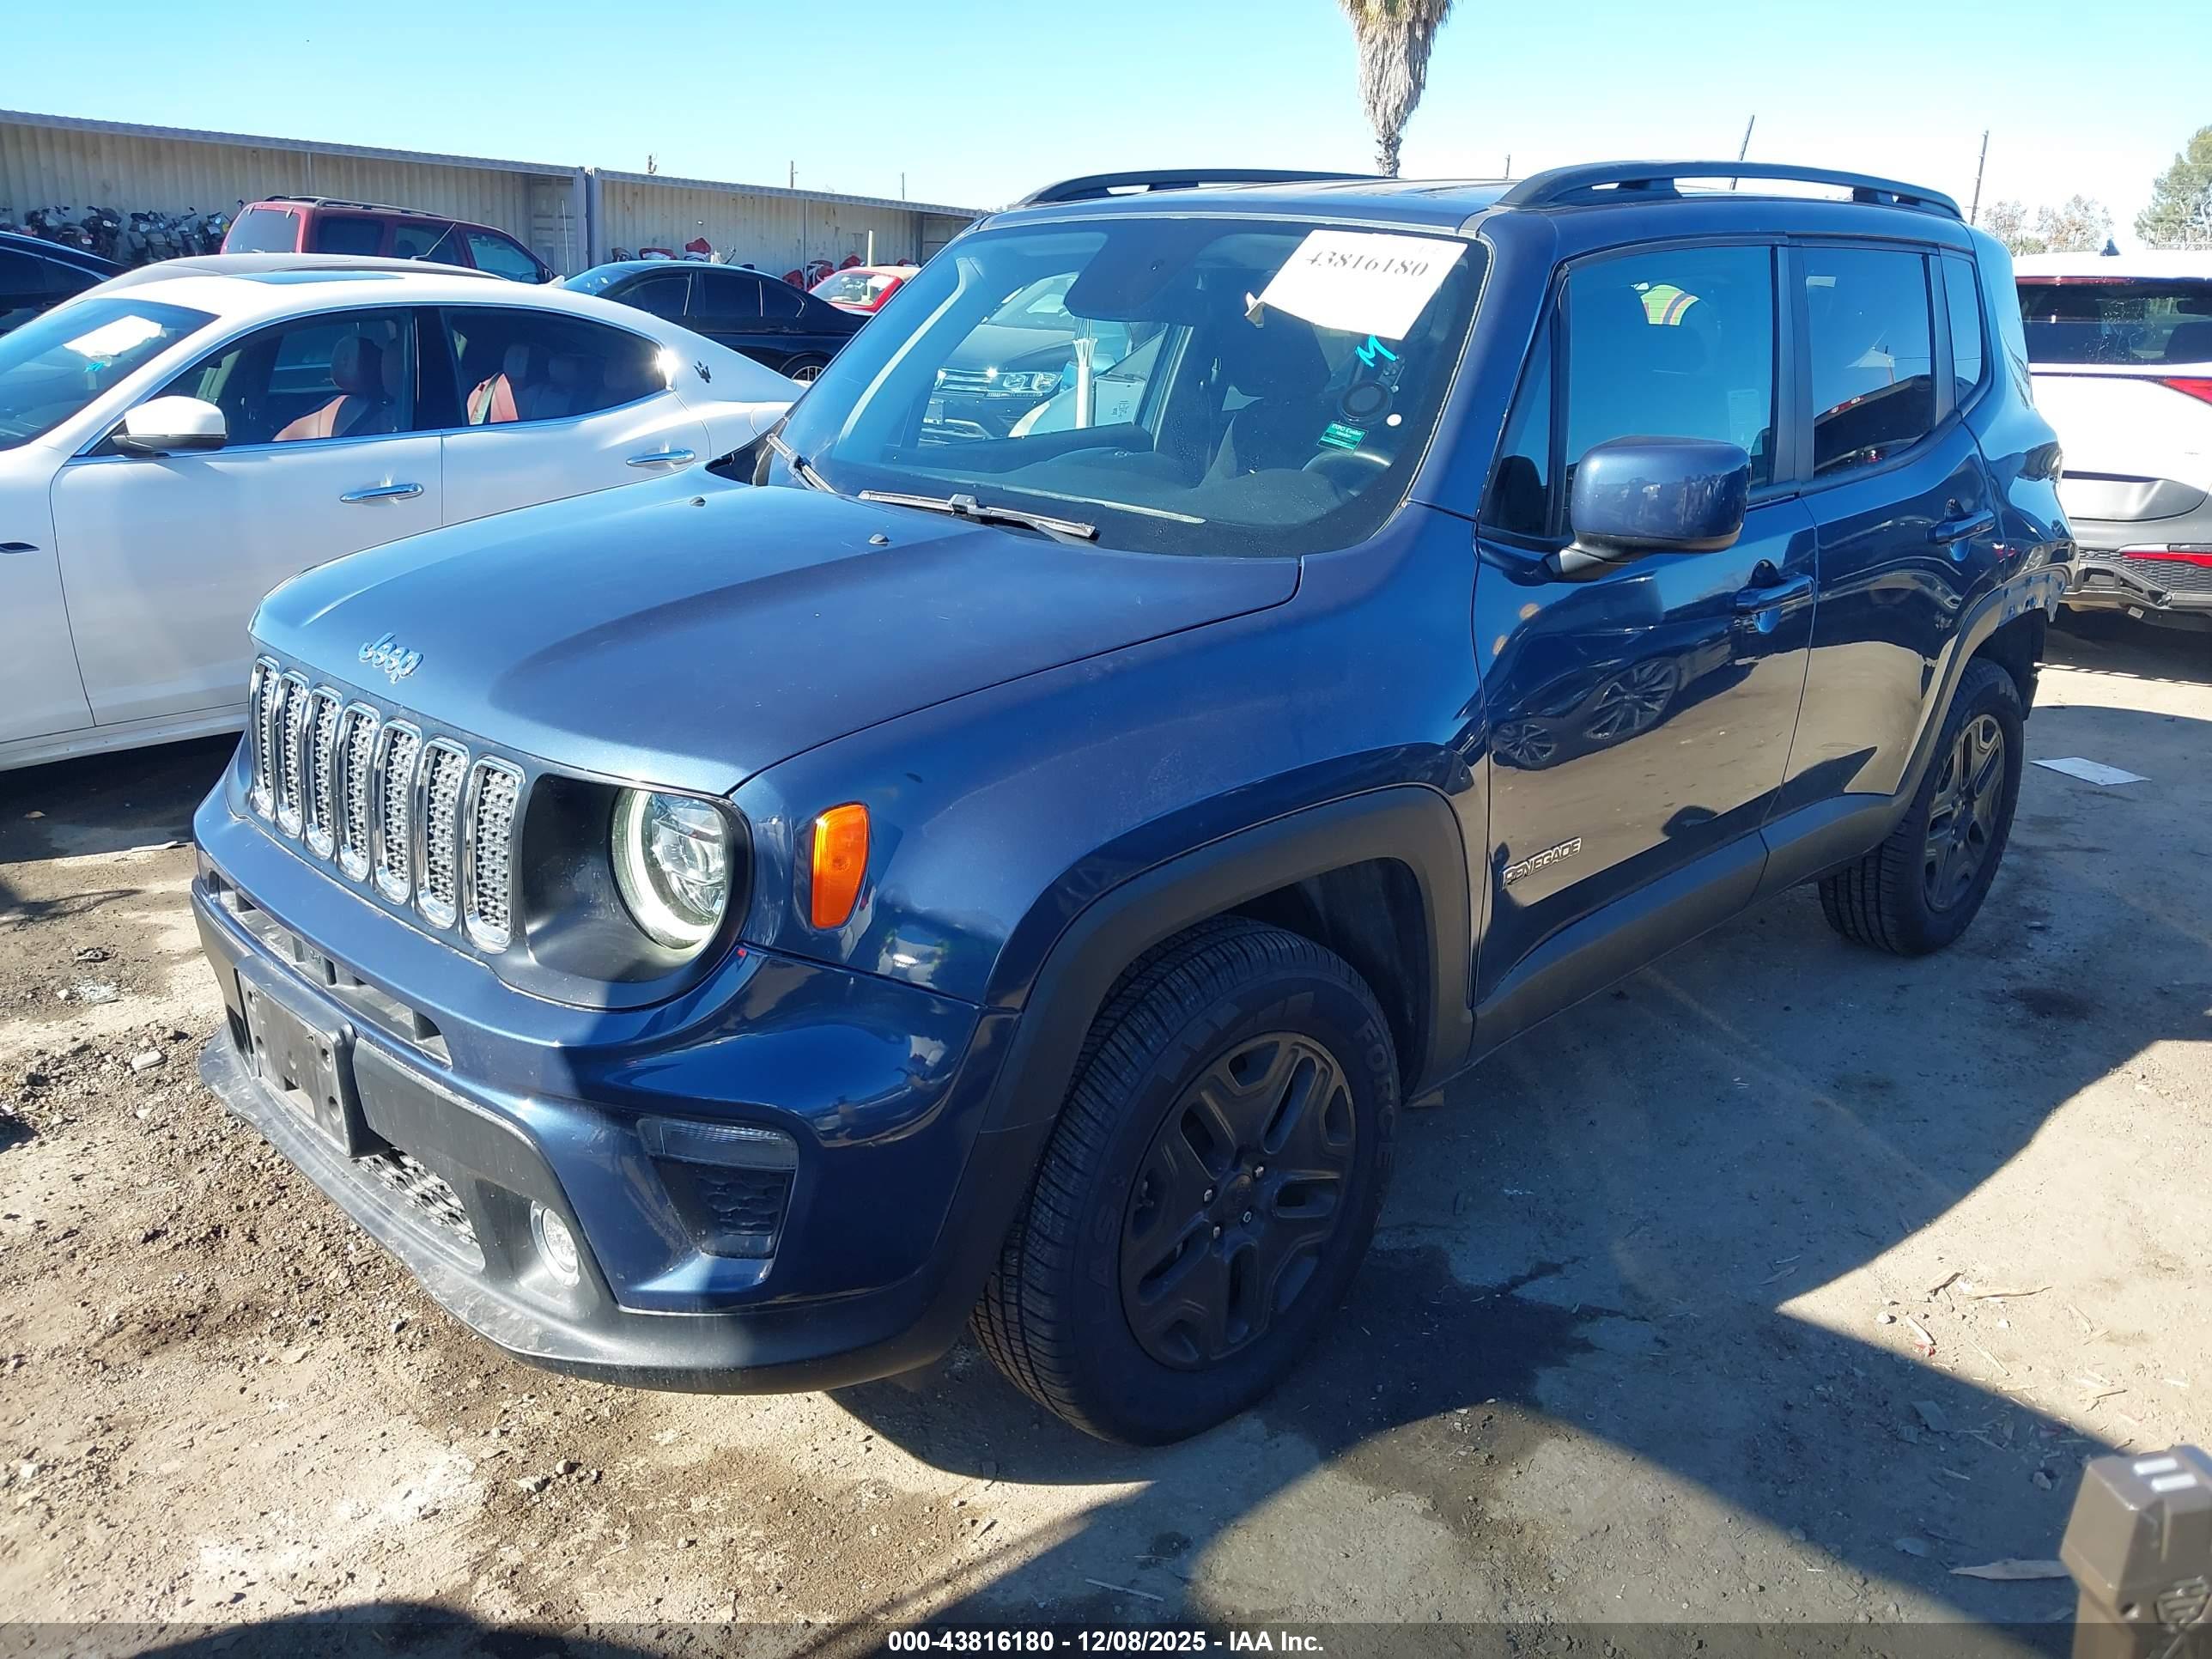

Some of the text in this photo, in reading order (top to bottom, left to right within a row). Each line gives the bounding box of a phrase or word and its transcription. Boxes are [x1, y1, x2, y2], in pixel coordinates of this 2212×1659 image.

[1306, 251, 1430, 276] 43816180
[358, 632, 424, 684] Jeep
[1352, 1018, 1396, 1169] FORCE
